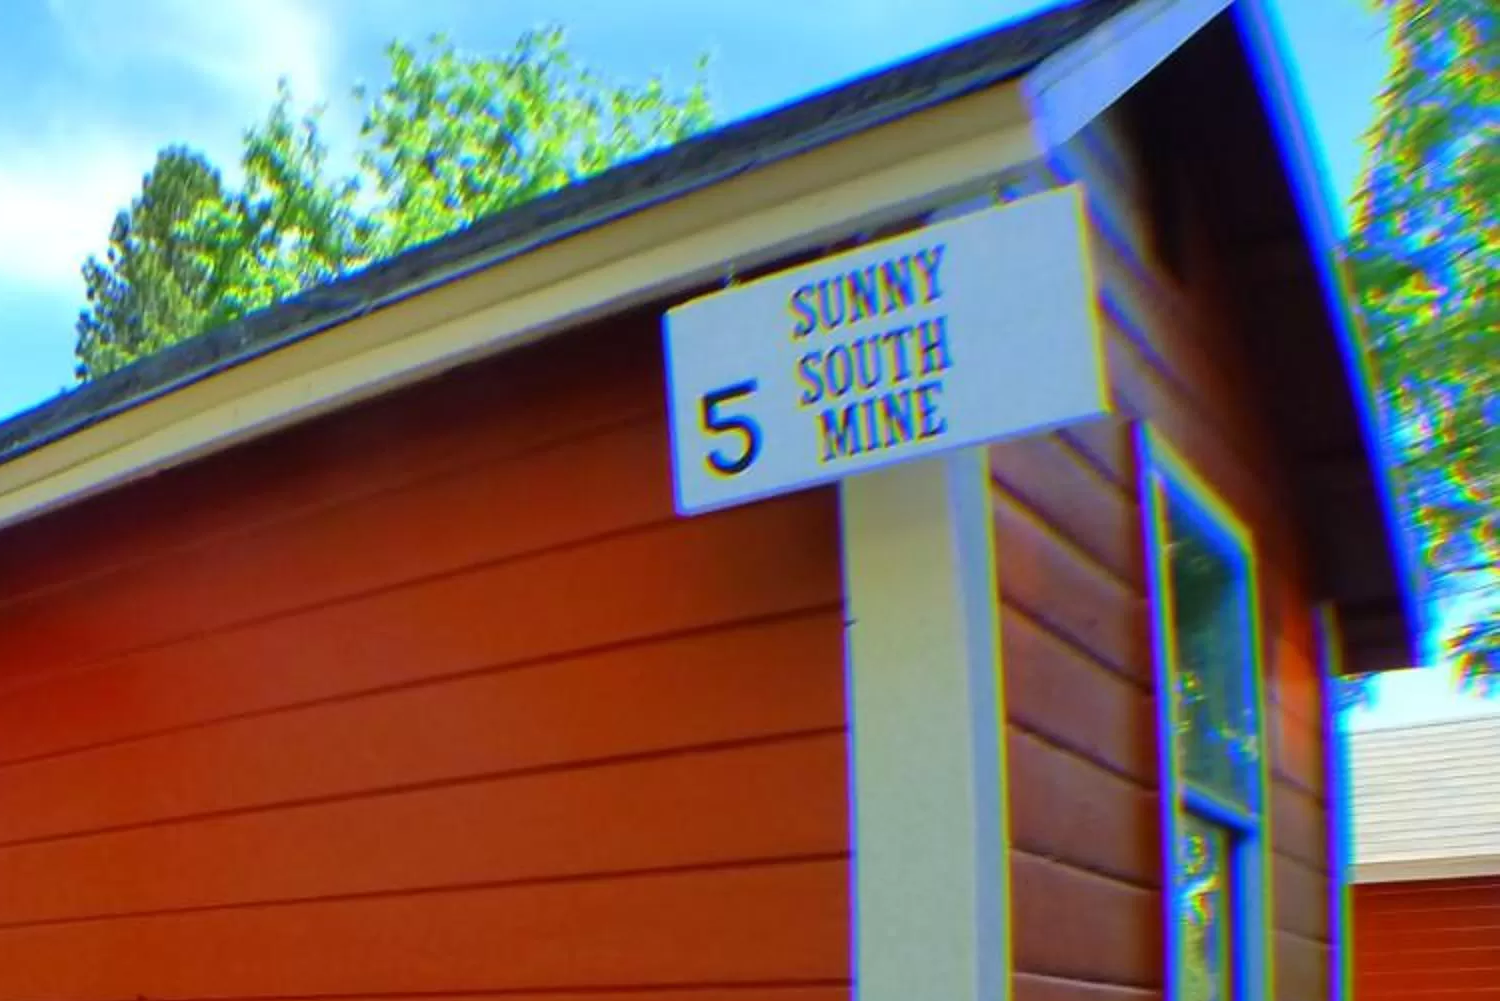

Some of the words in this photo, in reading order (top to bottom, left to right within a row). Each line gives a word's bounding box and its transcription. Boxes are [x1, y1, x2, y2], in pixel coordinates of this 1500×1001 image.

[790, 244, 946, 340] SUNNY
[797, 315, 953, 406] SOUTH
[701, 378, 763, 476] 5
[818, 381, 949, 462] MINE
